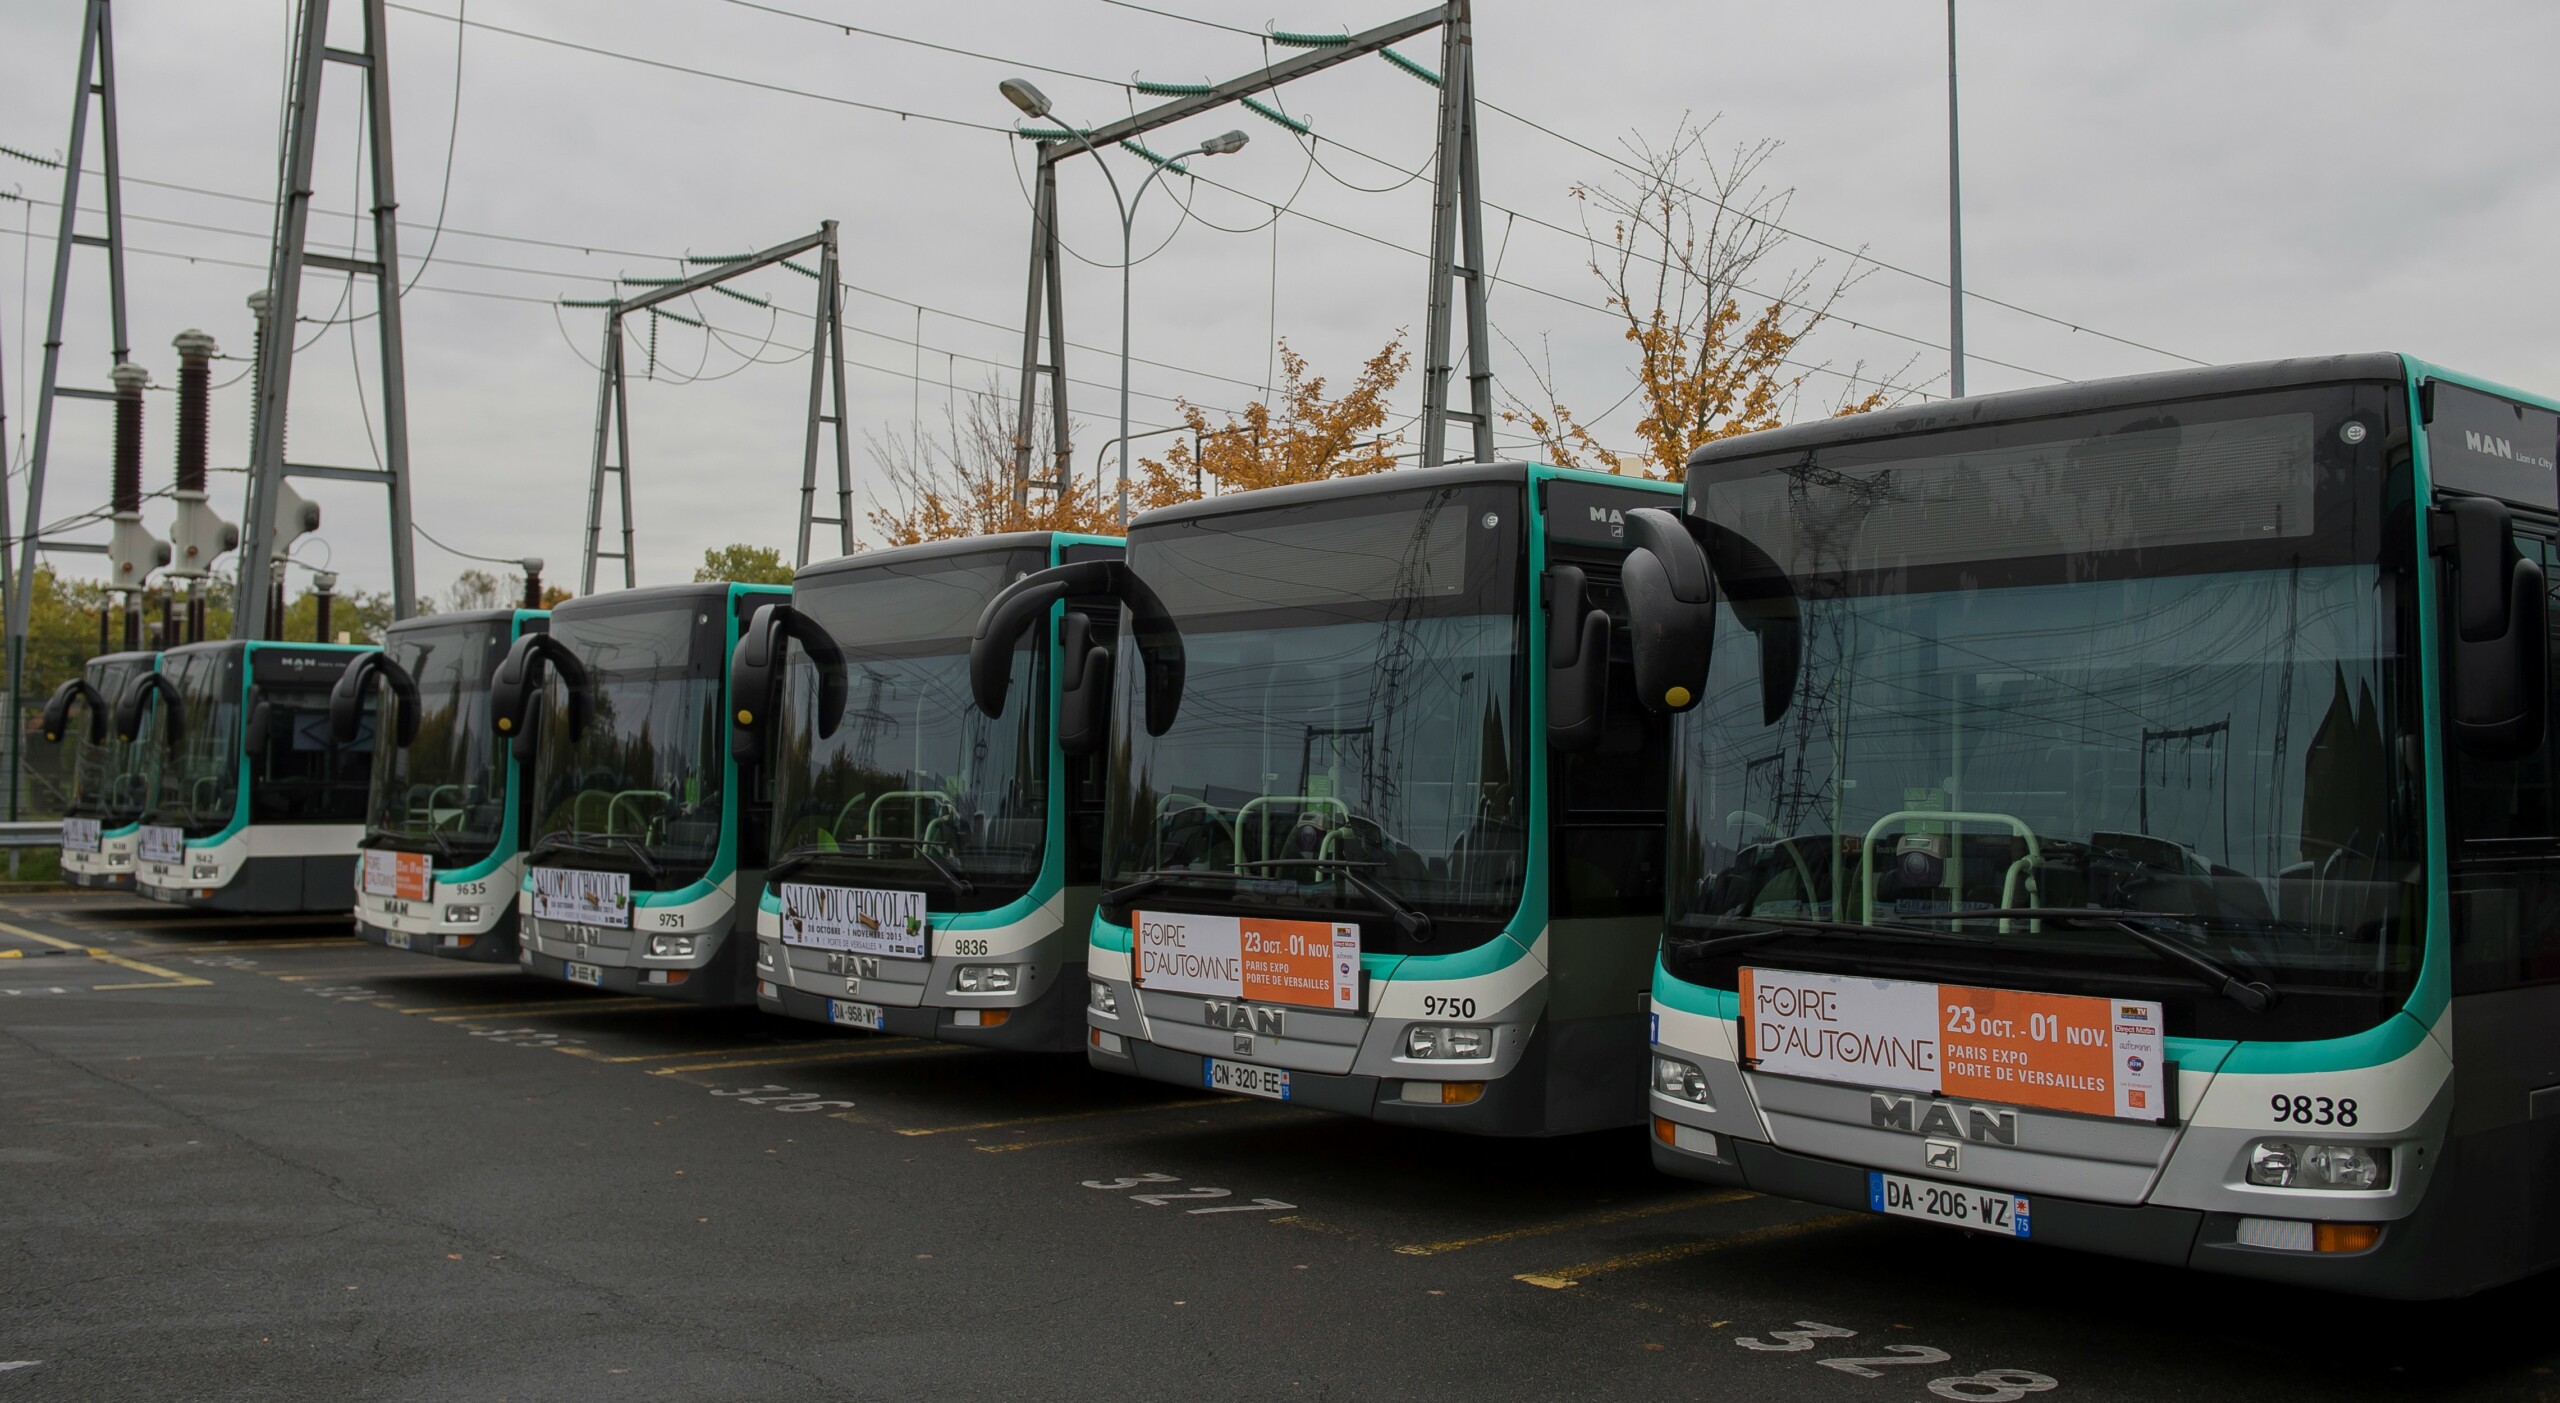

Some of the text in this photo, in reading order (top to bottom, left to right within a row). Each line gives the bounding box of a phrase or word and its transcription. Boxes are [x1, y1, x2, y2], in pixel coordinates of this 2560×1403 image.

[2465, 430, 2512, 459] MAN
[2538, 457, 2553, 471] City
[1589, 506, 1625, 525] MA
[456, 882, 487, 896] 9635
[659, 913, 685, 927] 9751
[785, 884, 920, 928] SALON DU CHOCOLAT
[564, 924, 600, 945] MAN
[816, 925, 841, 935] OCTOBRE
[852, 929, 885, 940] NOVEMBRE
[886, 931, 902, 941] 2015
[954, 939, 989, 956] 9836
[1142, 923, 1186, 947] FOIRE
[1245, 931, 1262, 953] 23
[1263, 940, 1283, 954] OCT.
[1290, 934, 1305, 957] 01
[1308, 943, 1331, 958] NOV.
[827, 953, 881, 979] MAN
[1143, 951, 1240, 981] D'AUTOMNE
[1246, 960, 1289, 974] PARIS EXPO
[1246, 972, 1330, 990] PORTE DE VERSAILLES
[1204, 1000, 1286, 1036] MAN
[1424, 995, 1477, 1019] 9750
[1758, 985, 1838, 1022] FOIRE
[1946, 1004, 1976, 1035] 23
[1980, 1018, 2017, 1039] OCT.
[2030, 1012, 2059, 1043] 01
[2066, 1026, 2109, 1048] NOV.
[2115, 1024, 2155, 1035] Direct Matin
[1761, 1022, 1935, 1073] D'AUTOMNE
[1948, 1044, 2028, 1066] PARIS EXPO
[1215, 1064, 1280, 1094] CN-320-EE
[1948, 1060, 2105, 1092] PORTE DE VERSAILLES
[709, 1084, 856, 1113] 326
[2270, 1093, 2359, 1128] 9838
[1870, 1092, 2019, 1147] MAN
[1081, 1172, 1298, 1215] 327
[1886, 1180, 2010, 1228] DA-206-WZ
[2015, 1217, 2030, 1233] 75
[1735, 1320, 2059, 1403] 328
